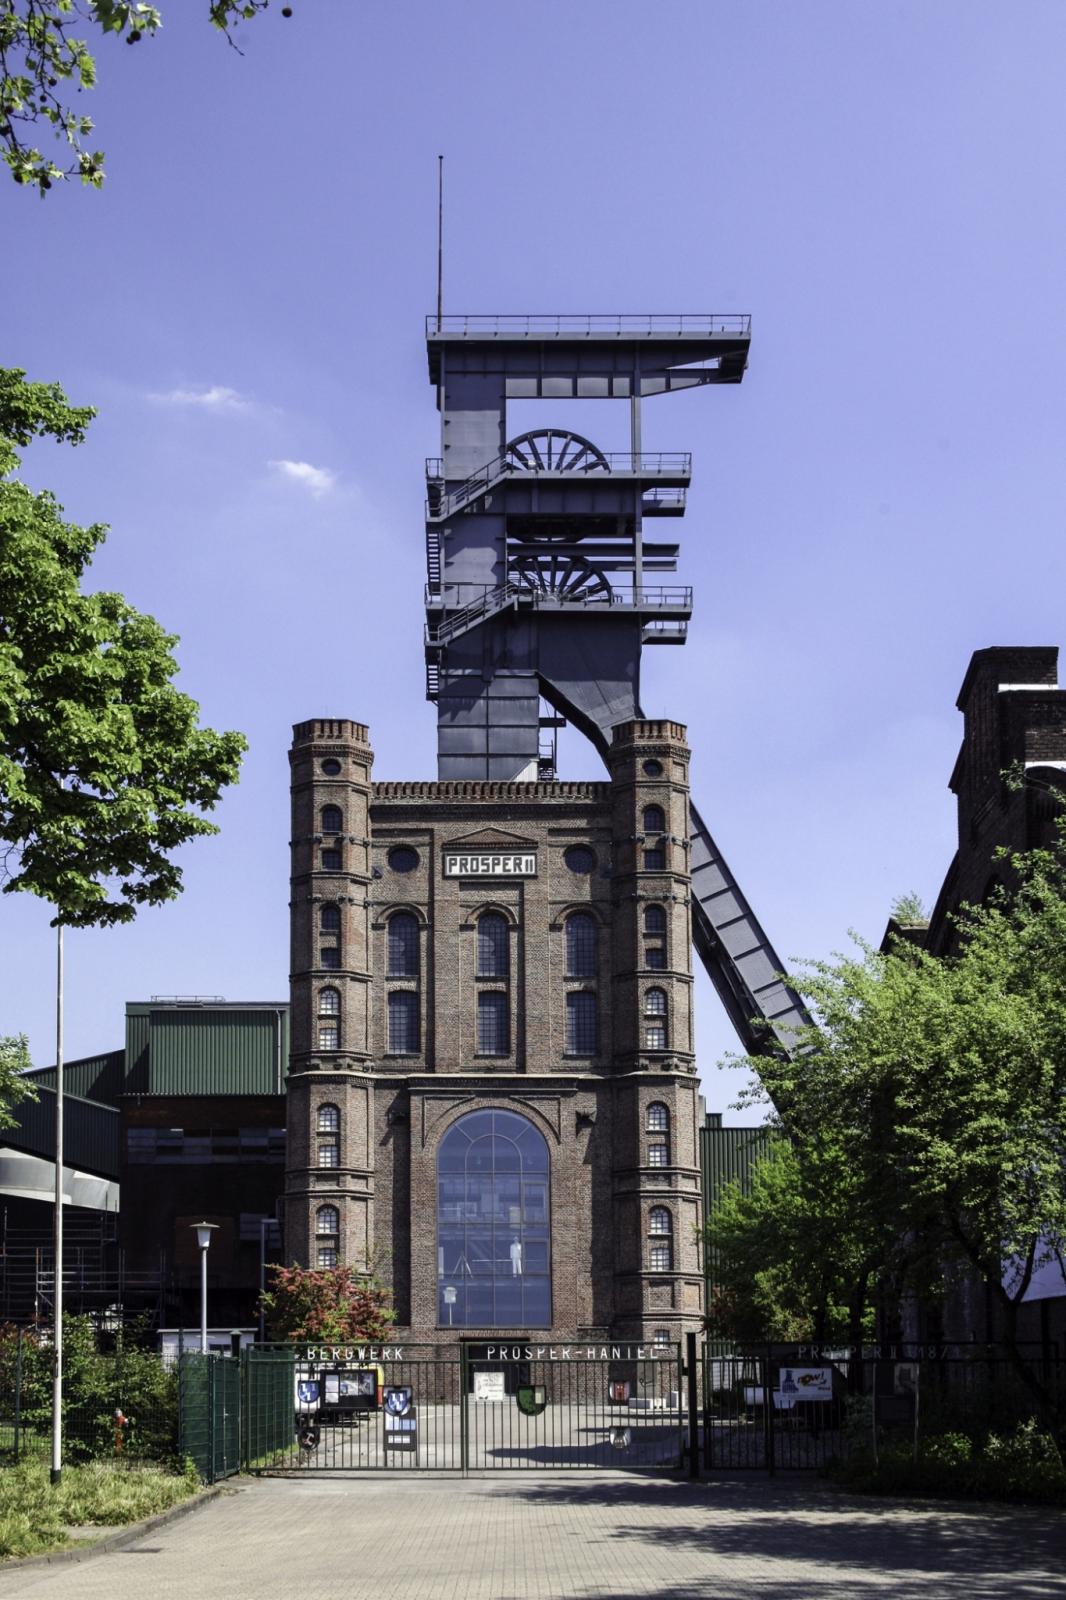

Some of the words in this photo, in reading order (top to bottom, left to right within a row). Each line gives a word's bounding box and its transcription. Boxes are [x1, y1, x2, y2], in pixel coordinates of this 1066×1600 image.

[448, 857, 522, 873] PROSPER
[307, 1345, 403, 1361] BERGWERK
[487, 1344, 659, 1360] PROSPER-HANIEL
